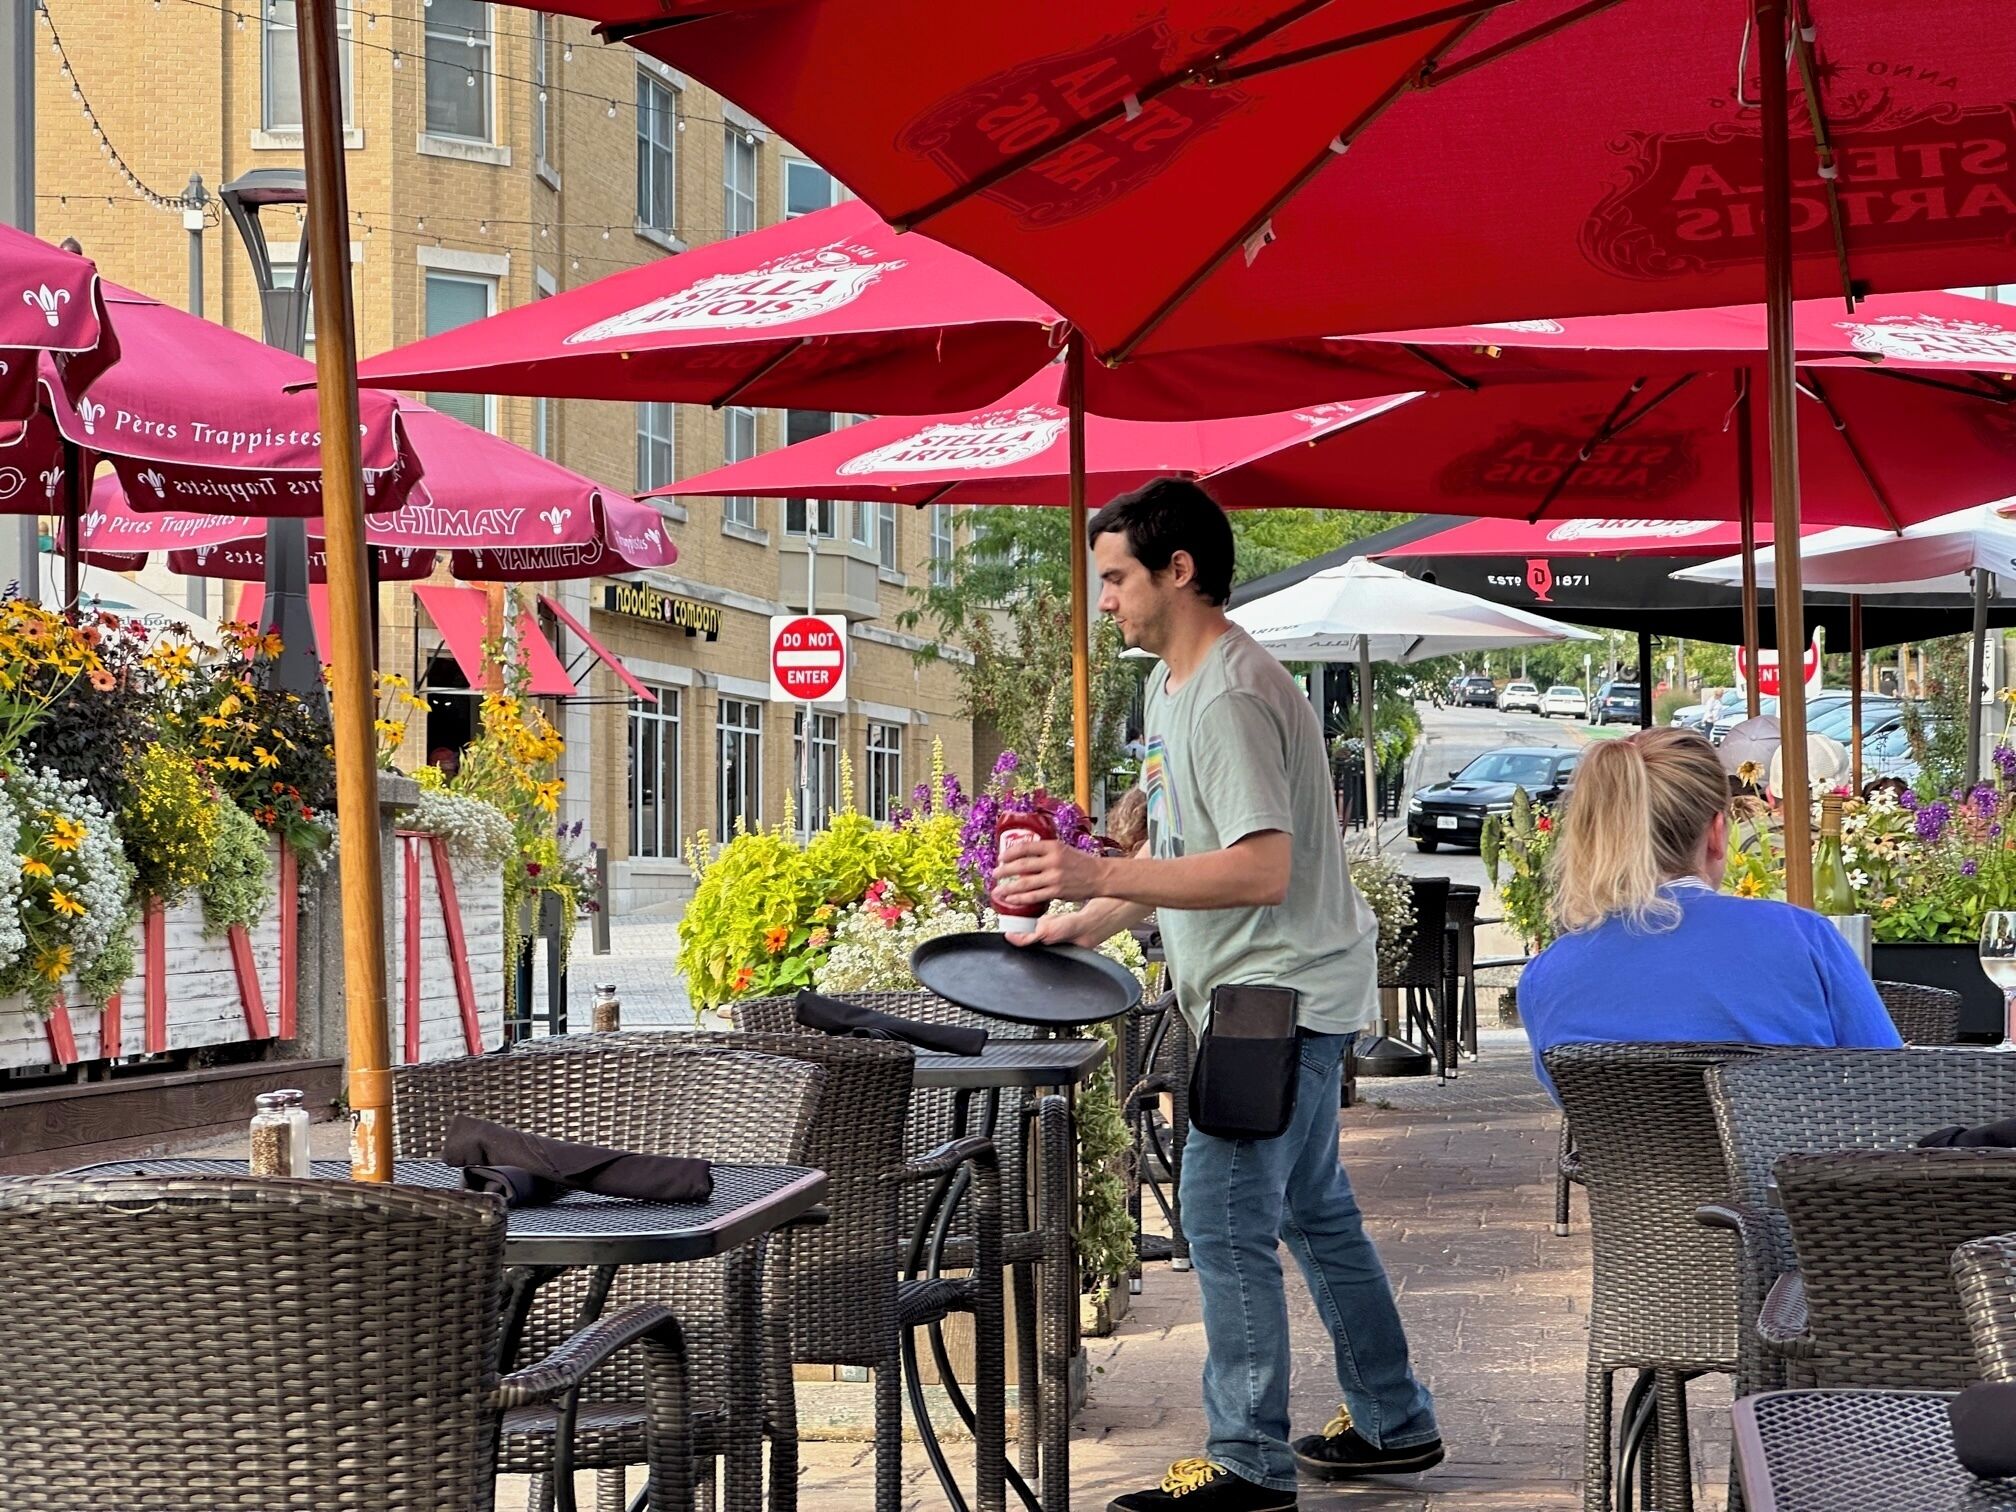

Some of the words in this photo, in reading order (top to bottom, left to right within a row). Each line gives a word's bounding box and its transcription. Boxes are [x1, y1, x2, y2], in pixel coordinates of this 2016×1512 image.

[673, 279, 838, 305] STELLA
[636, 299, 806, 326] ARTOIS
[114, 410, 178, 439] Pères
[191, 421, 321, 454] Trappistes
[912, 430, 1036, 448] STELLA
[882, 445, 1016, 462] ARTOIS
[108, 516, 153, 533] Pères
[364, 504, 526, 537] CHIMAY
[1555, 574, 1590, 587] 1871
[615, 581, 662, 620] noodles
[674, 599, 723, 634] company
[783, 633, 801, 647] DO
[808, 632, 834, 647] NOT
[787, 670, 829, 685] ENTER
